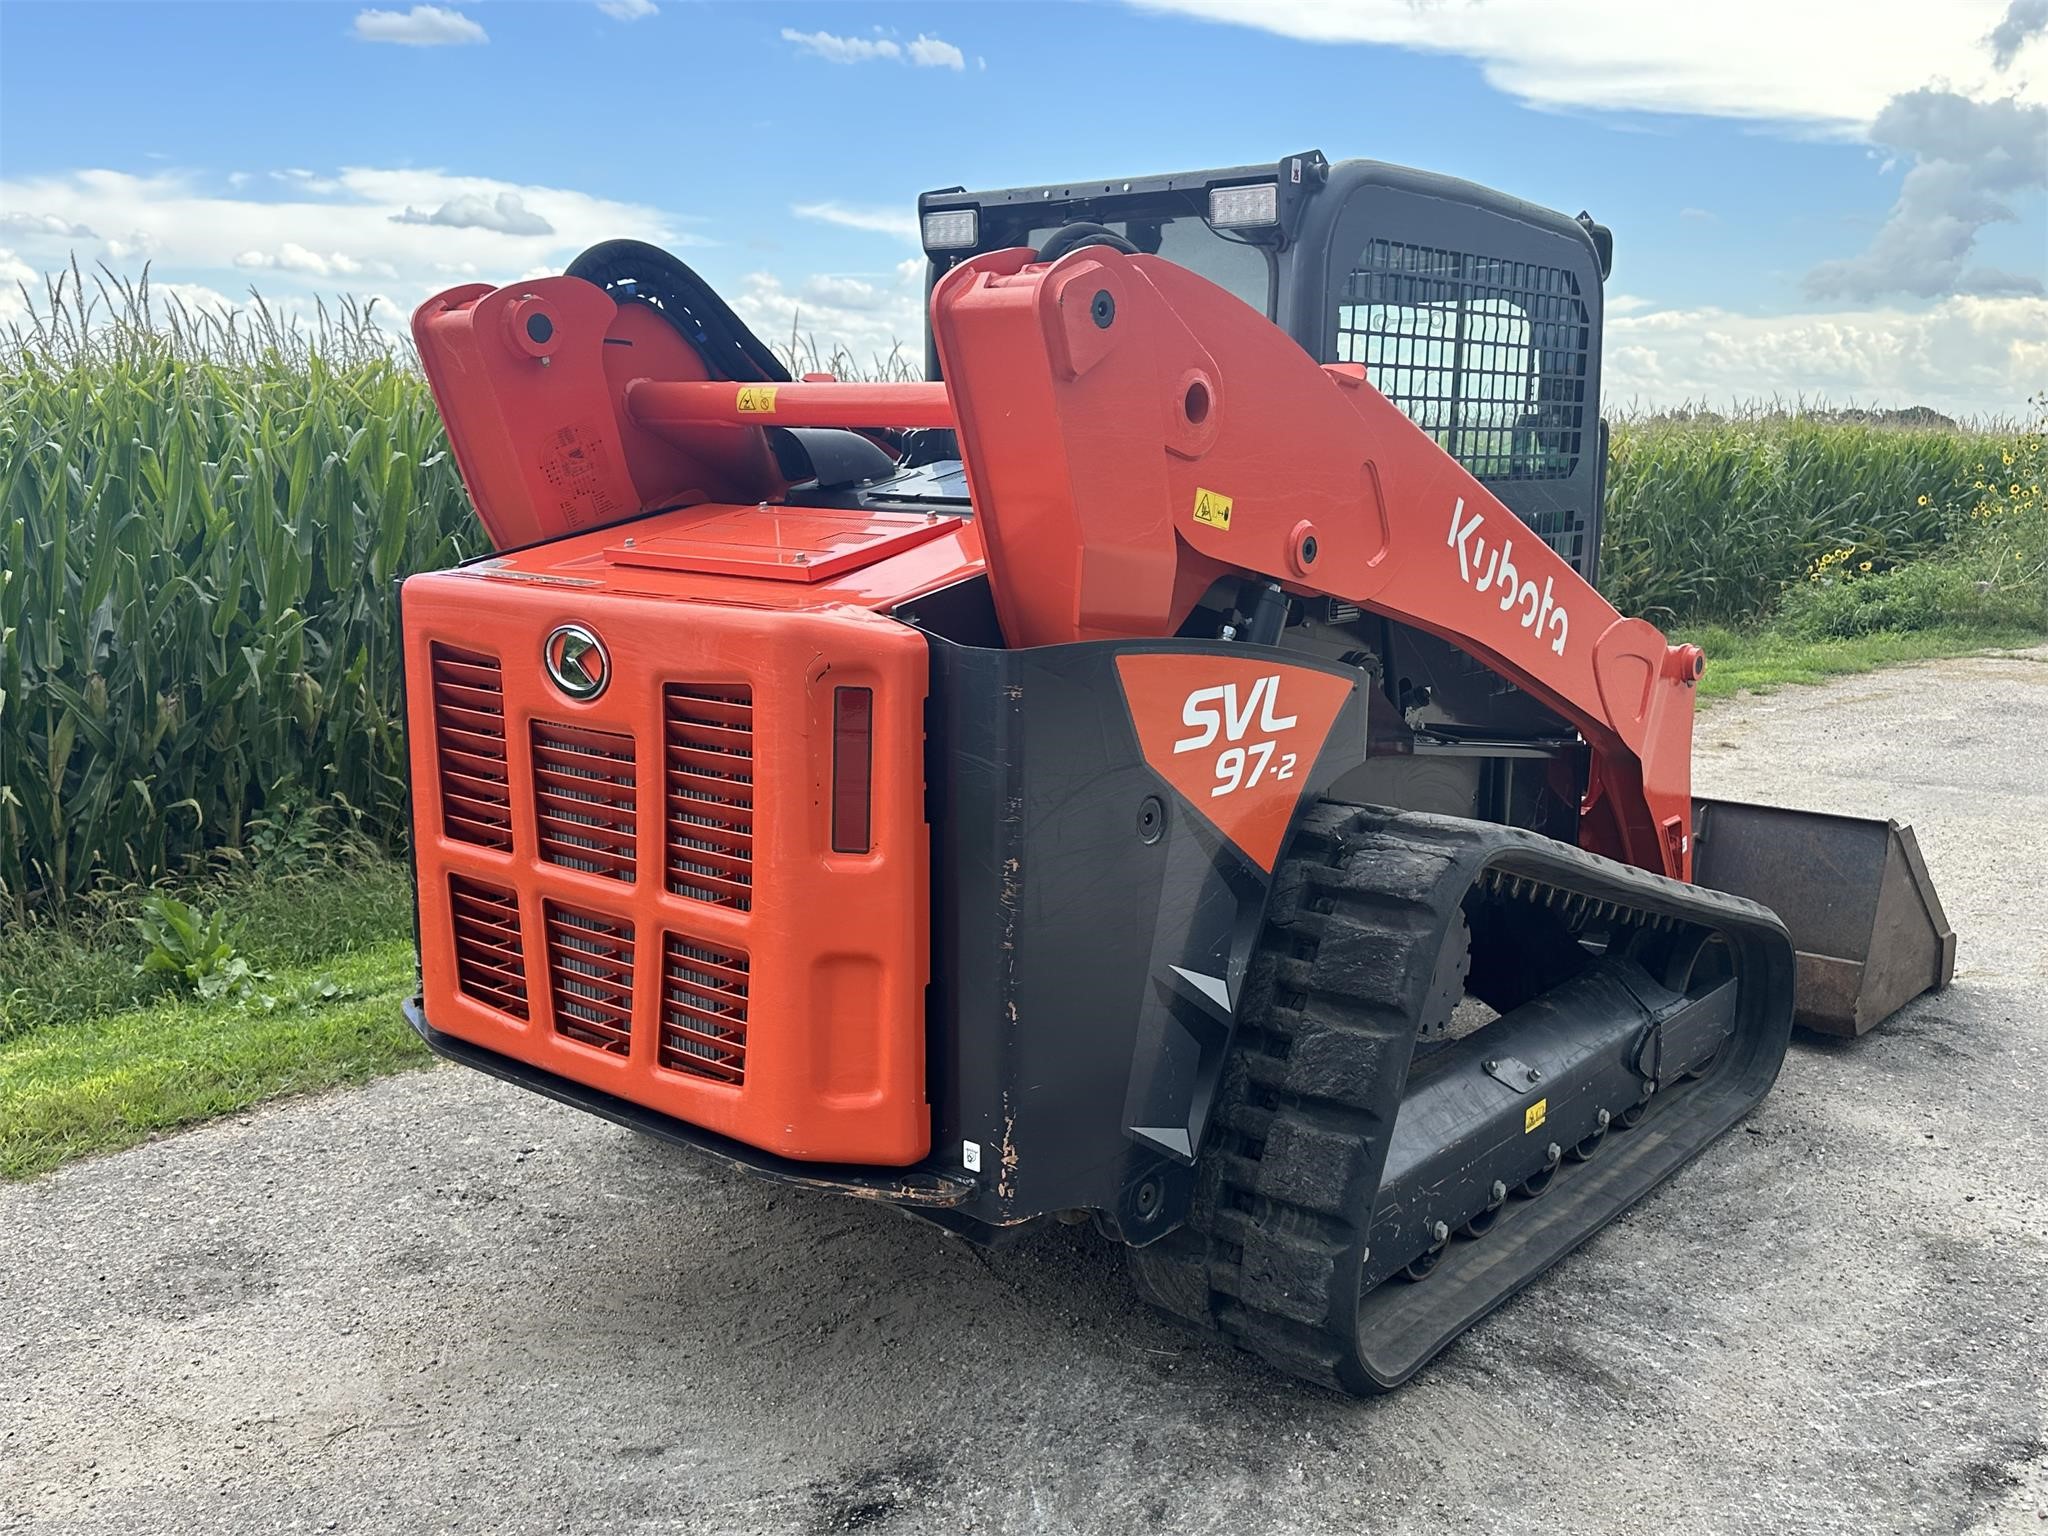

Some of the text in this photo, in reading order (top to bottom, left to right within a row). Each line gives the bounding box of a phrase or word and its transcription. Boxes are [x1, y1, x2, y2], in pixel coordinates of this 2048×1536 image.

[1447, 497, 1568, 656] Kubota
[1174, 675, 1297, 754] SVL
[1211, 740, 1296, 797] 97-2
